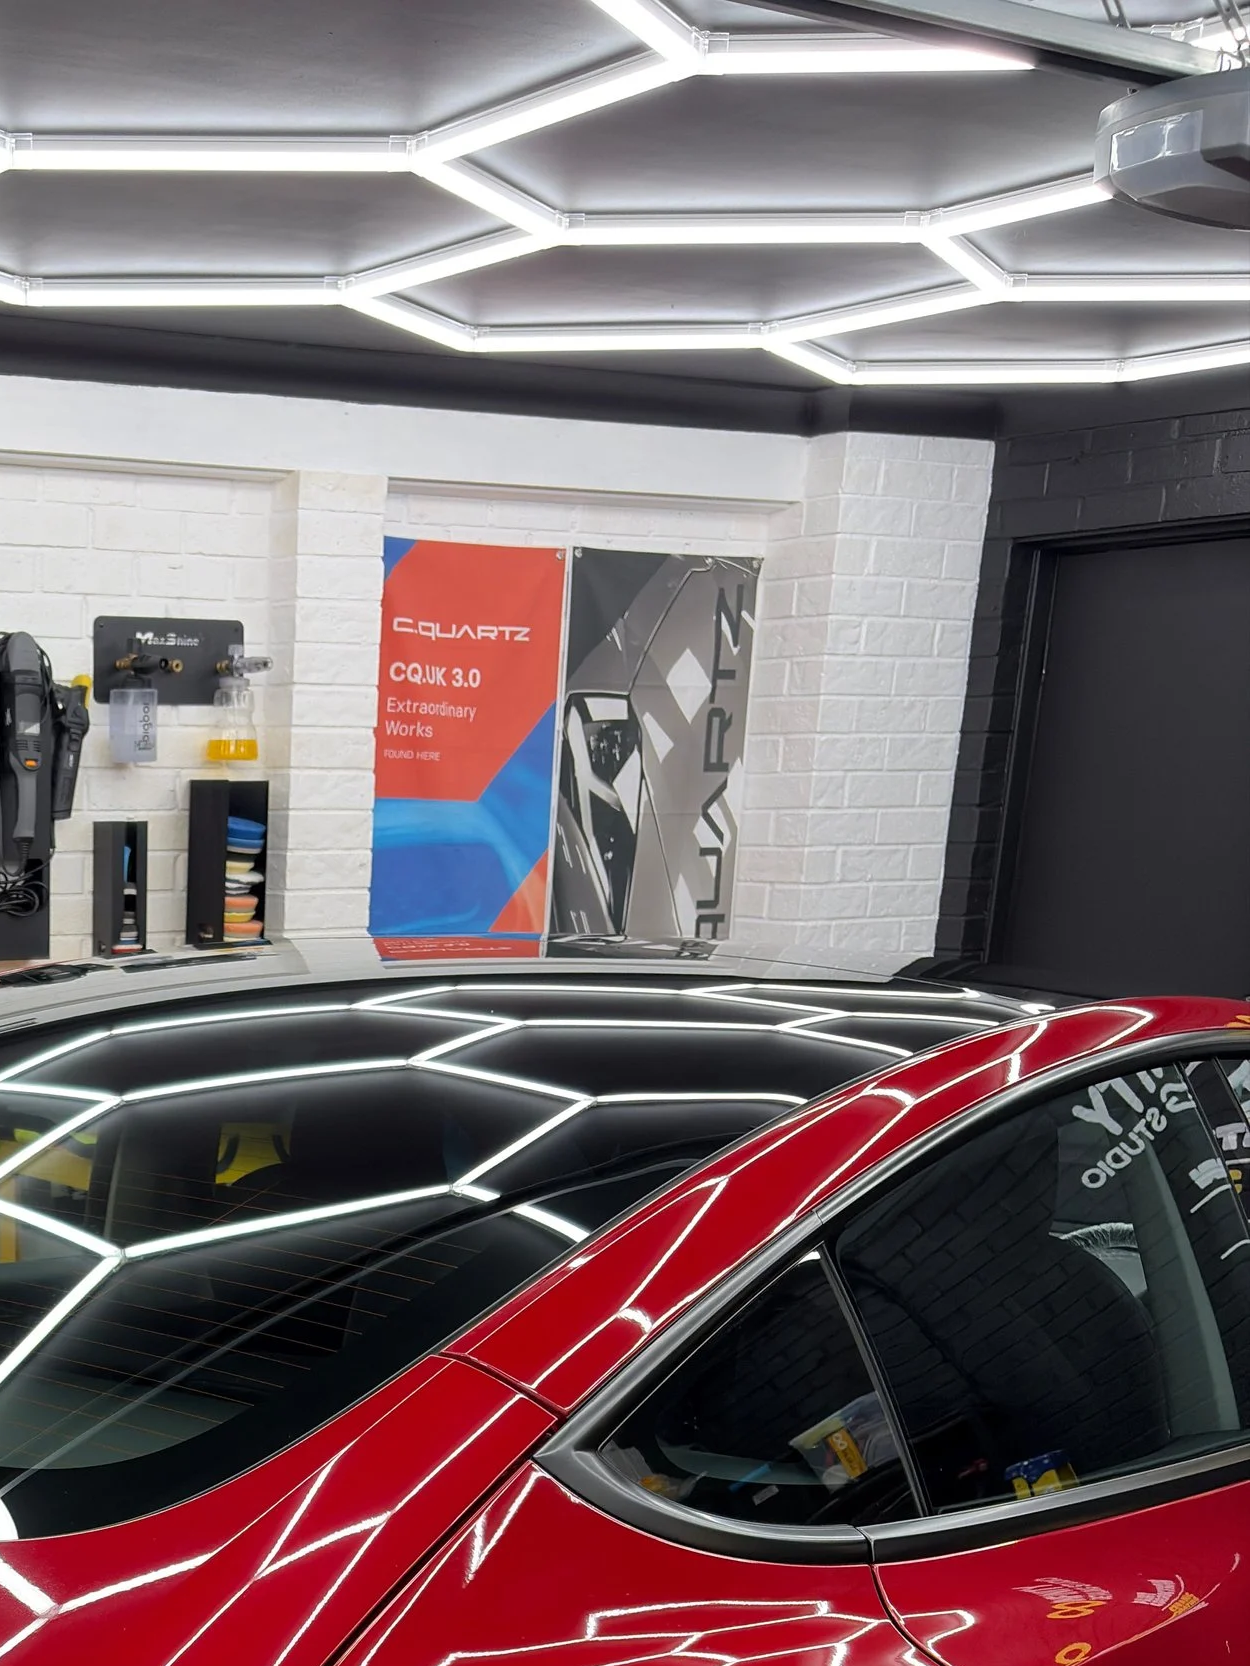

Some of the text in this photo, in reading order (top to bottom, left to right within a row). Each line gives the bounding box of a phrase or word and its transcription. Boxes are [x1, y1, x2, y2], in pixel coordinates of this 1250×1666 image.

[389, 661, 481, 688] CQ.UK 3.0
[386, 697, 477, 722] Extraordinary
[385, 720, 434, 738] Works
[383, 748, 441, 761] FOUND HERE
